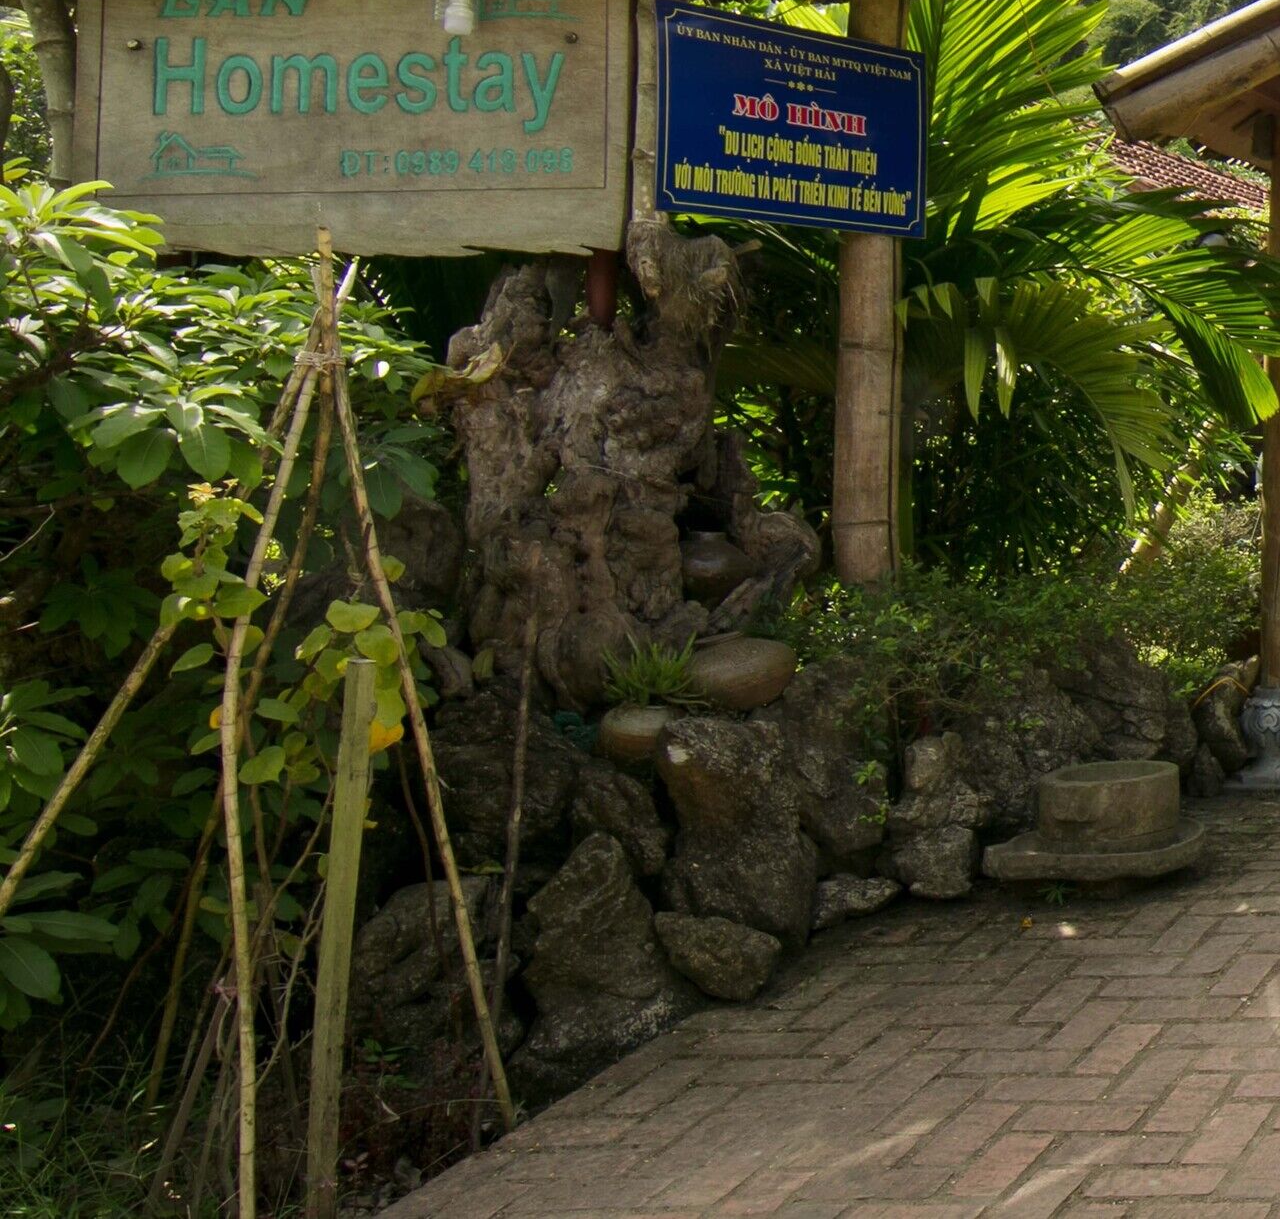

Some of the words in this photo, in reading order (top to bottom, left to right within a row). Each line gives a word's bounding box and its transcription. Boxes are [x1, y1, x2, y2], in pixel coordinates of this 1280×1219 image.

[676, 22, 695, 37] ỦY
[696, 28, 720, 43] BAN
[723, 35, 757, 50] NHÂN
[759, 41, 782, 55] DÂN
[790, 45, 806, 60] ỦY
[808, 51, 830, 64] BAN
[832, 57, 862, 73] MTTQ
[863, 62, 887, 77] VIỆT
[889, 68, 912, 81] NAM
[784, 62, 812, 77] VIỆT
[153, 36, 565, 134] Homestay
[732, 92, 779, 121] MÔ
[786, 101, 867, 136] HÌNH
[742, 133, 764, 163] LỊCH
[767, 133, 793, 167] CỘNG
[824, 142, 849, 171] THÂN
[851, 147, 877, 180] THIỆN
[674, 157, 692, 189] VỚI
[693, 162, 714, 193] MÔI
[716, 165, 755, 198] TRƯỜNG
[758, 170, 770, 200] VÀ
[772, 173, 797, 203] PHÁT
[799, 172, 826, 206] TRIỂN
[827, 183, 849, 210] KINH
[851, 180, 863, 211] TẾ
